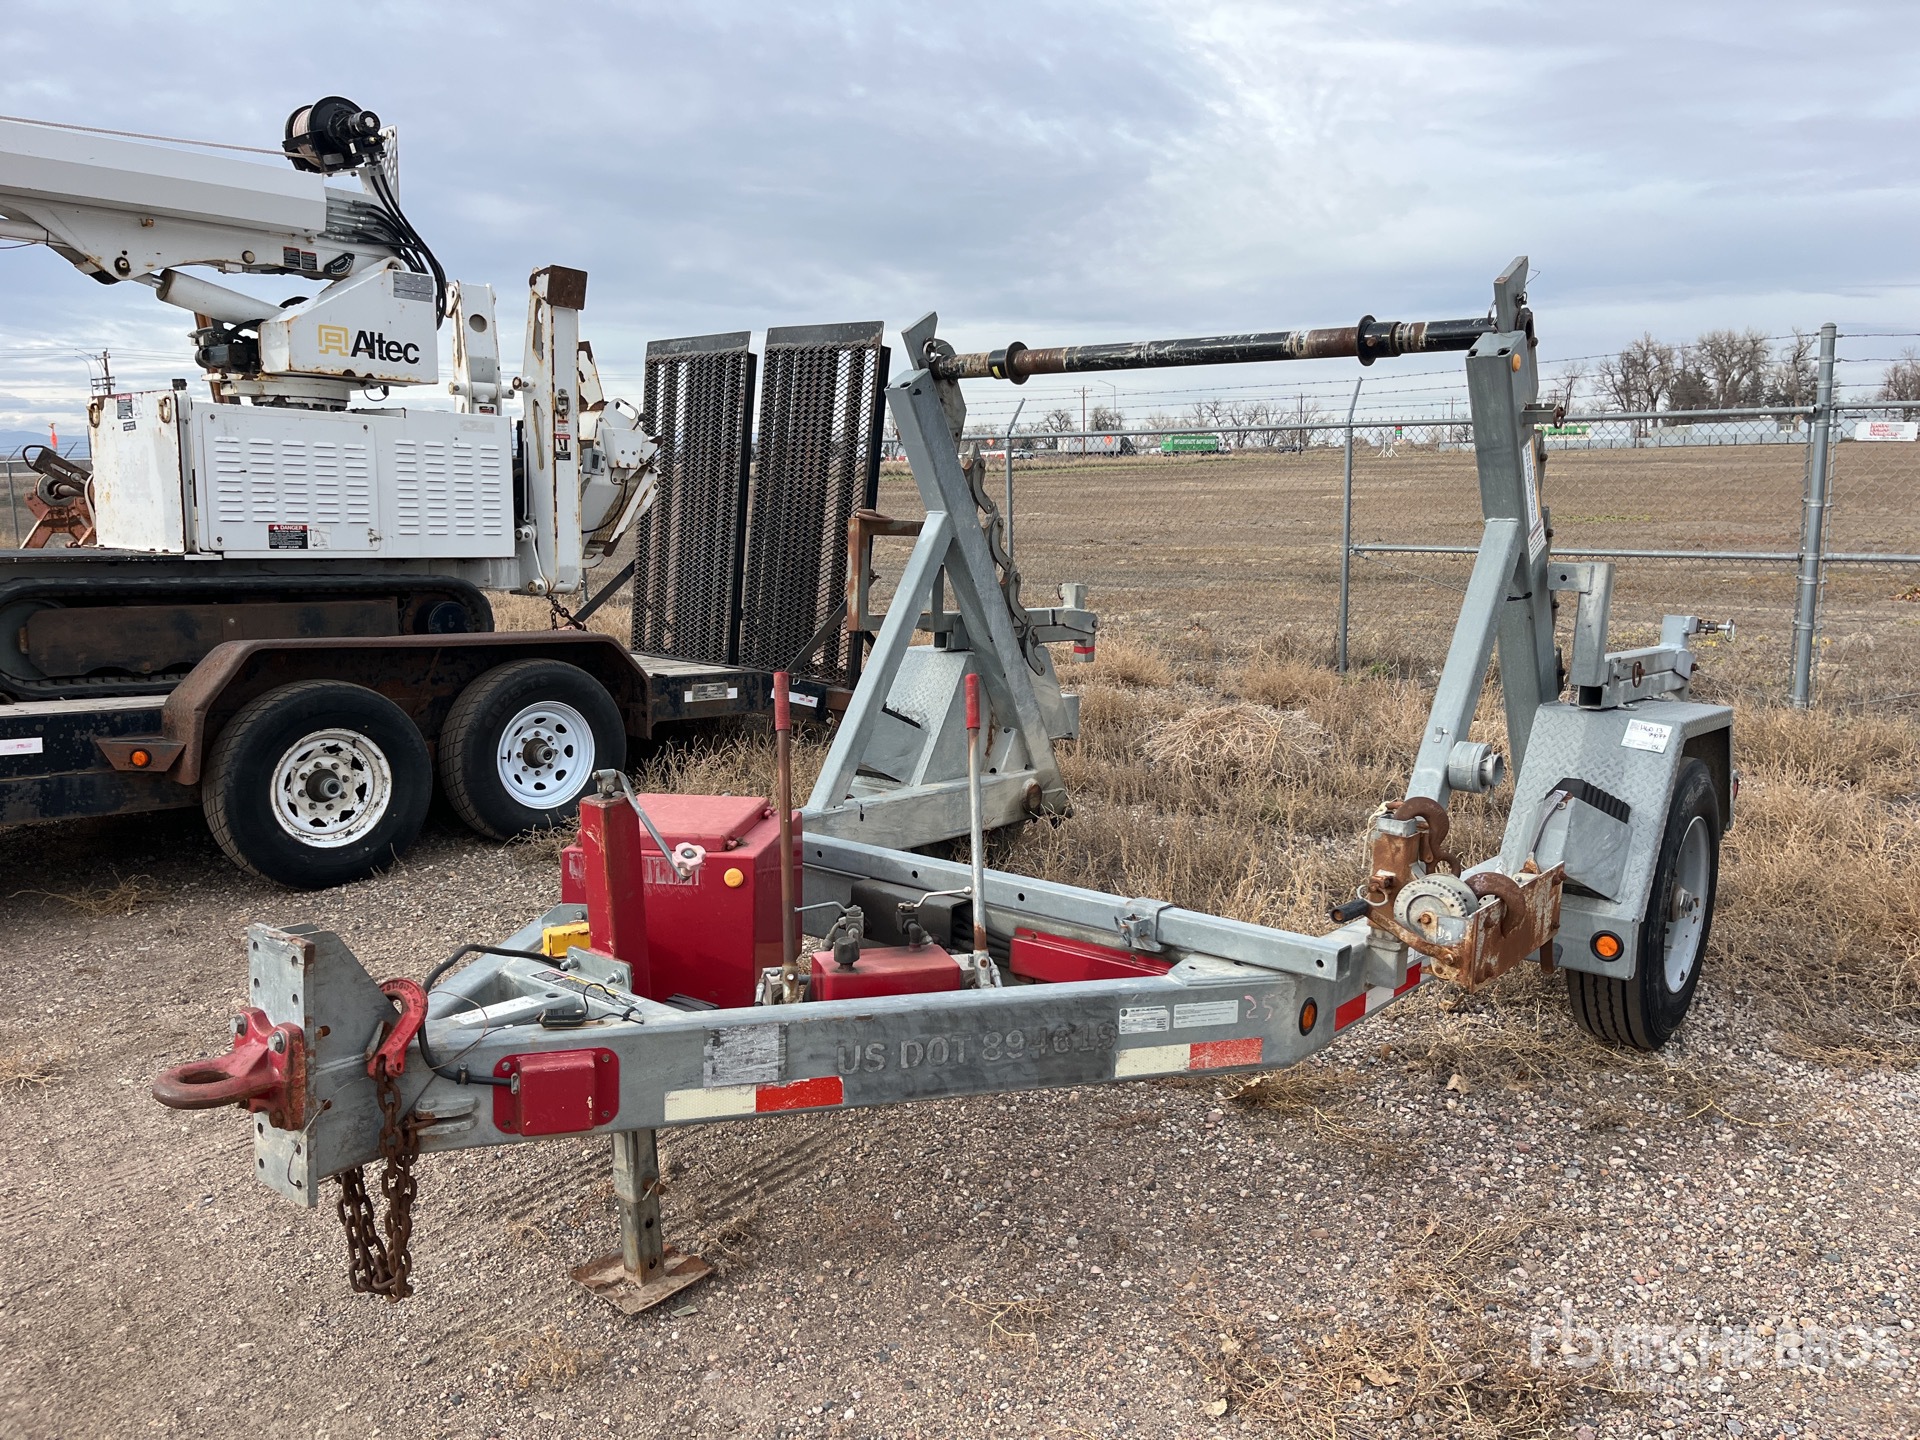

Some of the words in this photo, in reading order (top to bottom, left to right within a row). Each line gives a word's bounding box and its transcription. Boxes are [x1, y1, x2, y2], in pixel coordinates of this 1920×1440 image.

[350, 329, 420, 364] Altec
[836, 1043, 887, 1076] US
[899, 1034, 972, 1069] DOT
